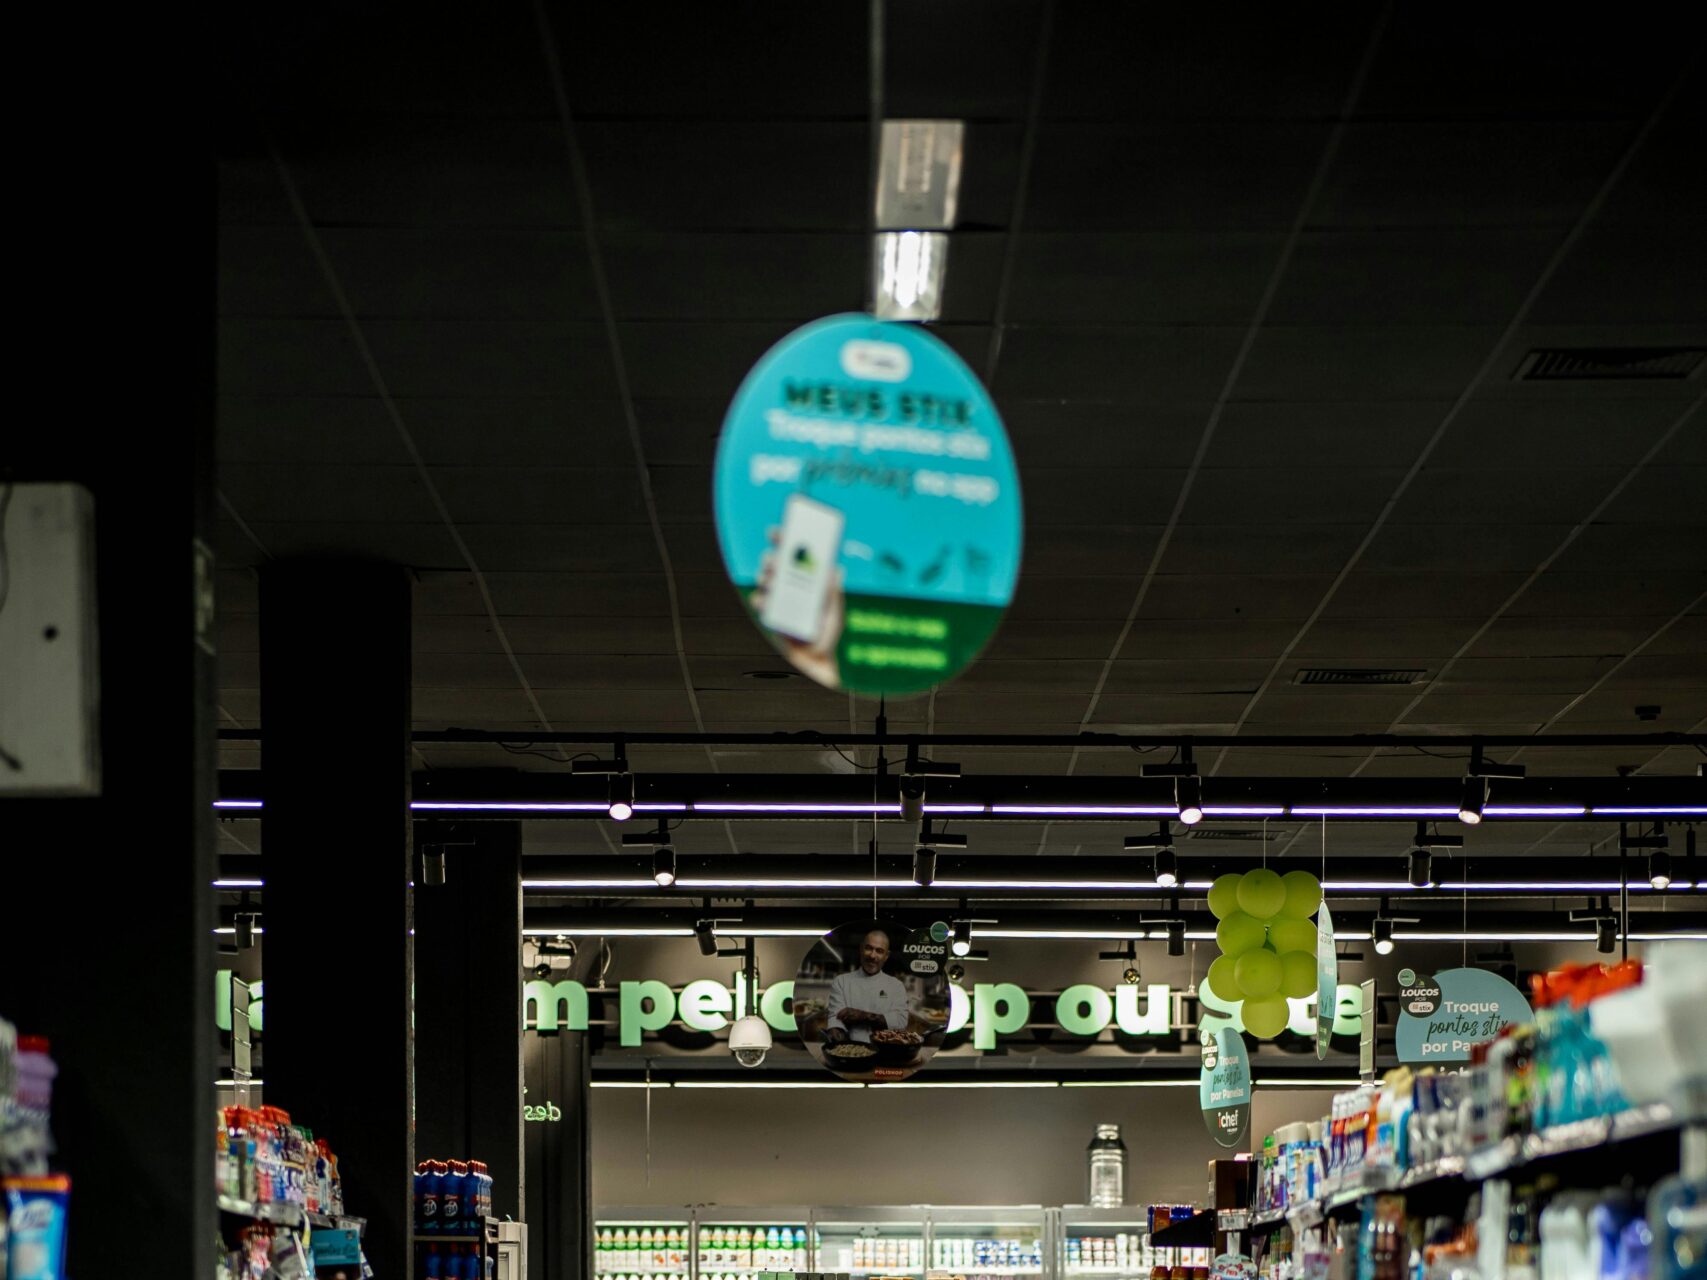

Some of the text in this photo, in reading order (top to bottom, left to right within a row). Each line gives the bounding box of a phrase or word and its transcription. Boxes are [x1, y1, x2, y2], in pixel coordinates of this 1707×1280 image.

[784, 382, 888, 417] MEUS
[903, 944, 945, 954] LOUCOS
[921, 962, 936, 971] stix
[1401, 988, 1440, 998] LOUCOS
[1055, 983, 1171, 1036] ou
[1198, 976, 1363, 1037] ste
[1418, 1004, 1431, 1012] stix
[1443, 1001, 1500, 1015] Troque
[1426, 1014, 1479, 1042] pontos
[1421, 1042, 1449, 1056] por
[1210, 1091, 1223, 1104] por
[1217, 1109, 1239, 1129] ichef
